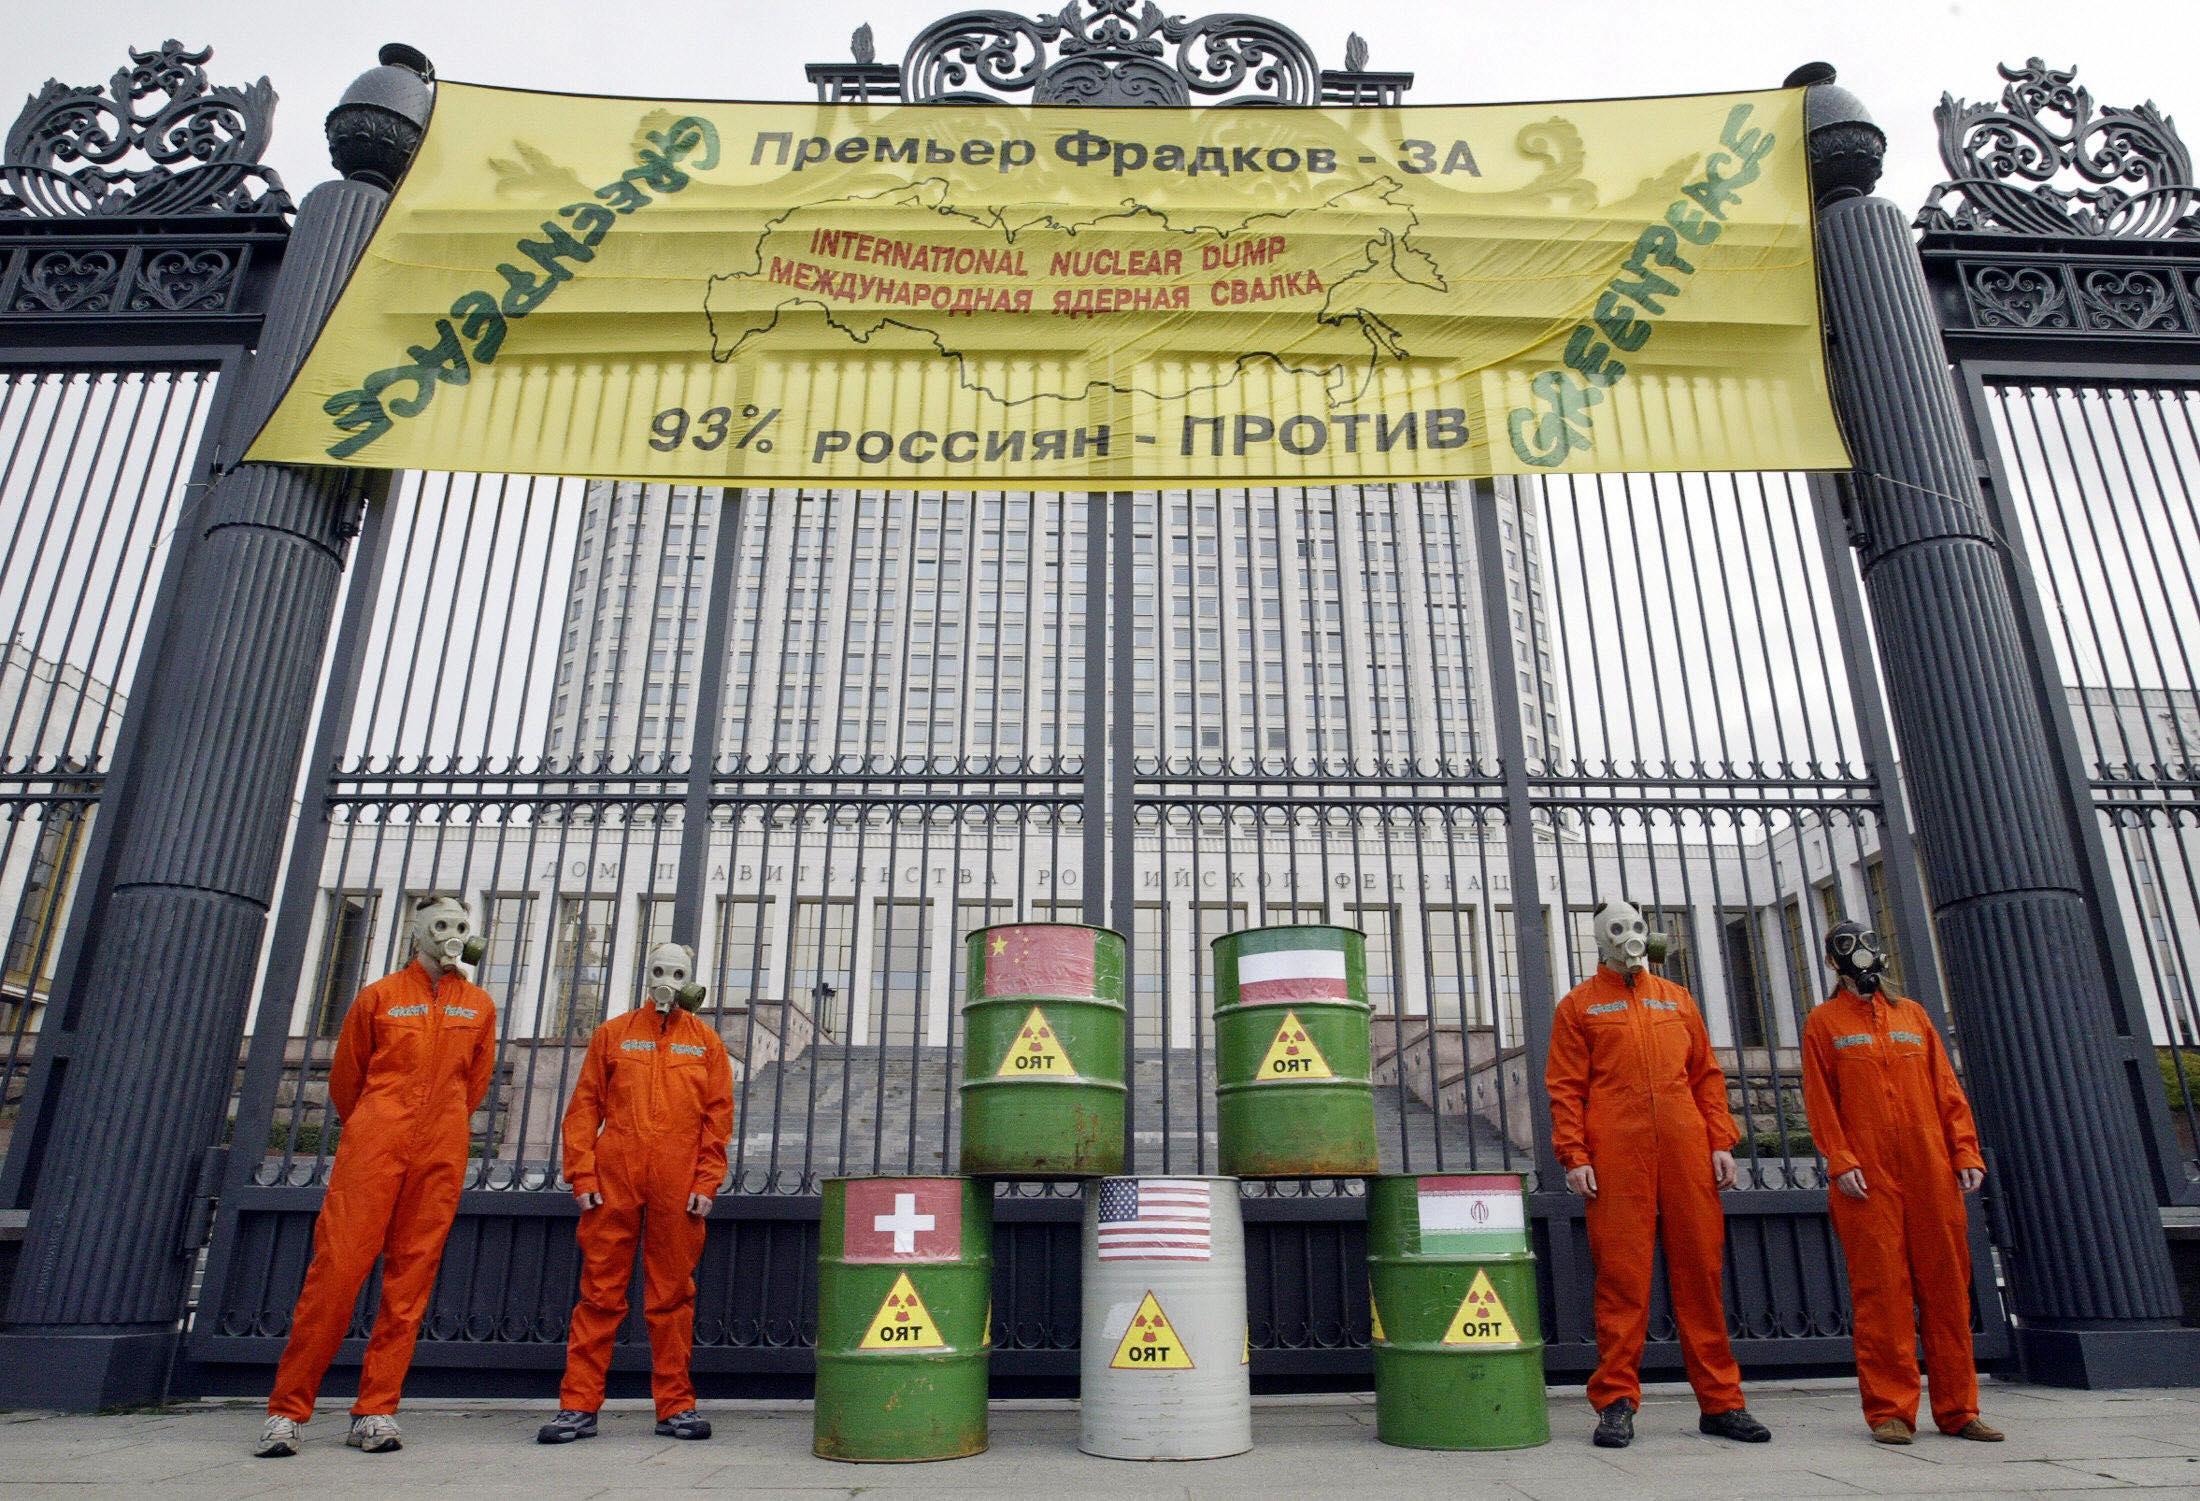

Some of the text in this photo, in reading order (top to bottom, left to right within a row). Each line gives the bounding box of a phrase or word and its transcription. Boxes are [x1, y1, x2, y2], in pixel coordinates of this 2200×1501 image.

[750, 130, 1036, 174] Премьер
[1054, 128, 1337, 178] Фрадков
[1398, 139, 1482, 178] ЗА
[810, 227, 1286, 277] INTERNATIONAL NUCLEAR DUMP
[322, 115, 721, 460] GREENPEACE
[768, 256, 1325, 320] МЕЖДУНАРОДНАЯ ЯДЕРНАЯ СВАЛКА
[1506, 102, 1776, 468] GREENPEACE
[648, 403, 1470, 465] 93% РОССИЯН - ПРОТИВ
[541, 860, 618, 879] ДОМ
[1037, 867, 1301, 890] РОИЙСКОЙ
[1015, 1054, 1056, 1071] ОЯТ
[1272, 1058, 1313, 1073] ОЯТ
[880, 1325, 923, 1343] ОЯТ
[1462, 1322, 1503, 1338] ОЯТ
[1128, 1346, 1171, 1363] ОЯТ
